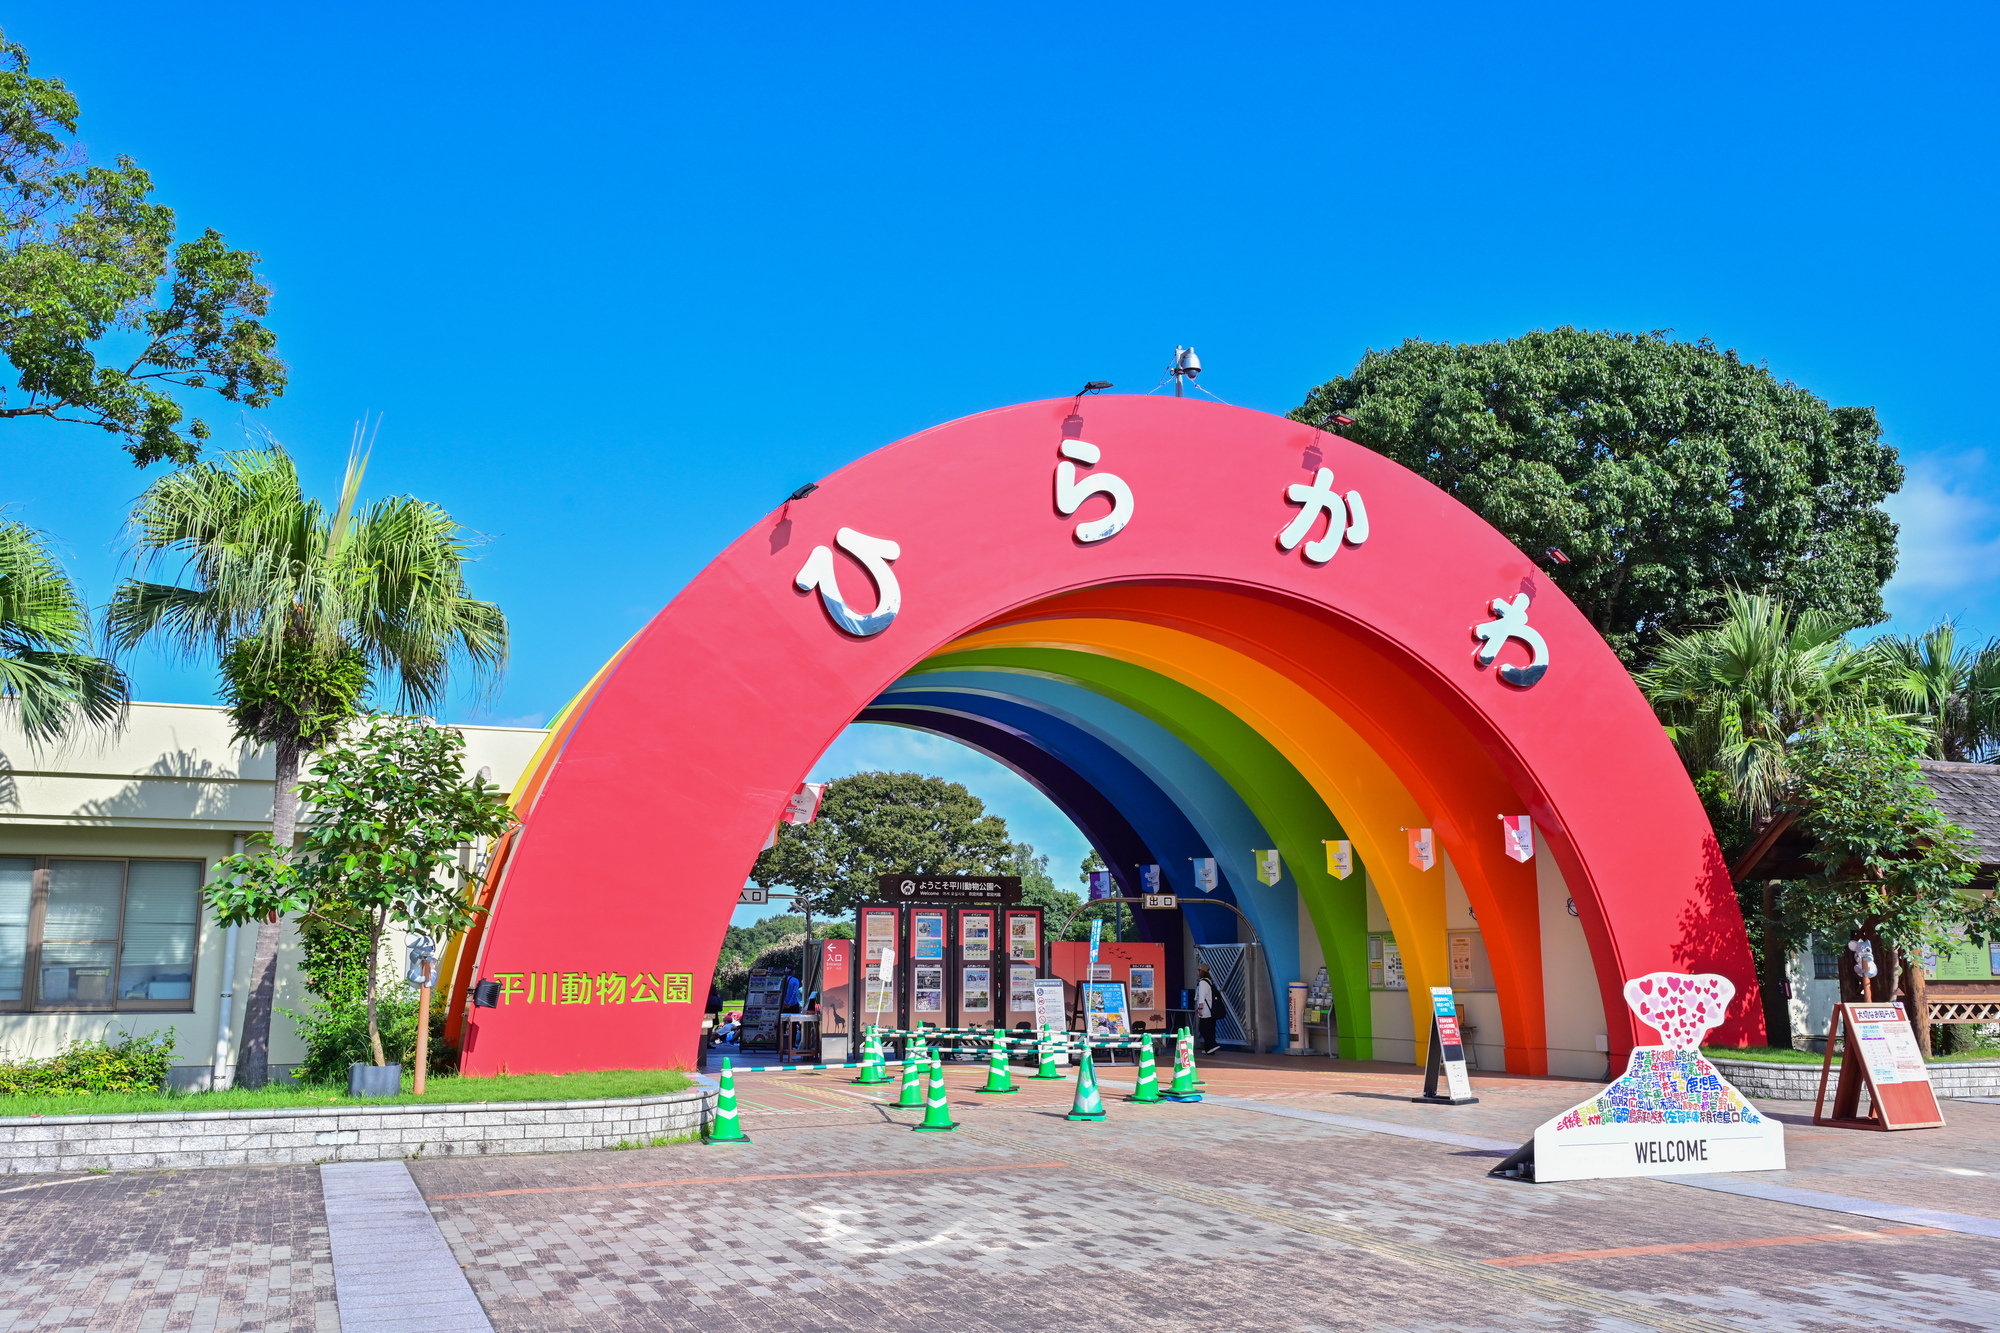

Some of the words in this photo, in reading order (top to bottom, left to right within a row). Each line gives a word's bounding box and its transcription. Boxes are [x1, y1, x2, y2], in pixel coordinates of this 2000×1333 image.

[793, 439, 1550, 688] ひらかわ
[919, 881, 1002, 891] ようこそ平川動物公園へ
[1149, 896, 1172, 906] 出口
[827, 954, 842, 962] 入口
[494, 972, 693, 1005] 平川動物公園
[1642, 1051, 1652, 1073] 青森
[1651, 1050, 1661, 1071] 秋田
[1680, 1049, 1698, 1062] 宮城
[1629, 1051, 1645, 1078] 北海道
[1686, 1074, 1723, 1093] 鹿児島
[1620, 1087, 1636, 1097] 福井
[1596, 1097, 1613, 1112] 香川
[1660, 1096, 1683, 1110] 和歌山
[1701, 1091, 1710, 1111] 京都
[1587, 1114, 1601, 1125] 大分
[1612, 1108, 1630, 1123] 福岡
[1636, 1109, 1651, 1123] 高知
[1663, 1111, 1685, 1124] 佐賀
[1713, 1110, 1732, 1124] 徳島
[1727, 1103, 1740, 1123] 山口
[1635, 1139, 1708, 1163] WELCOME
